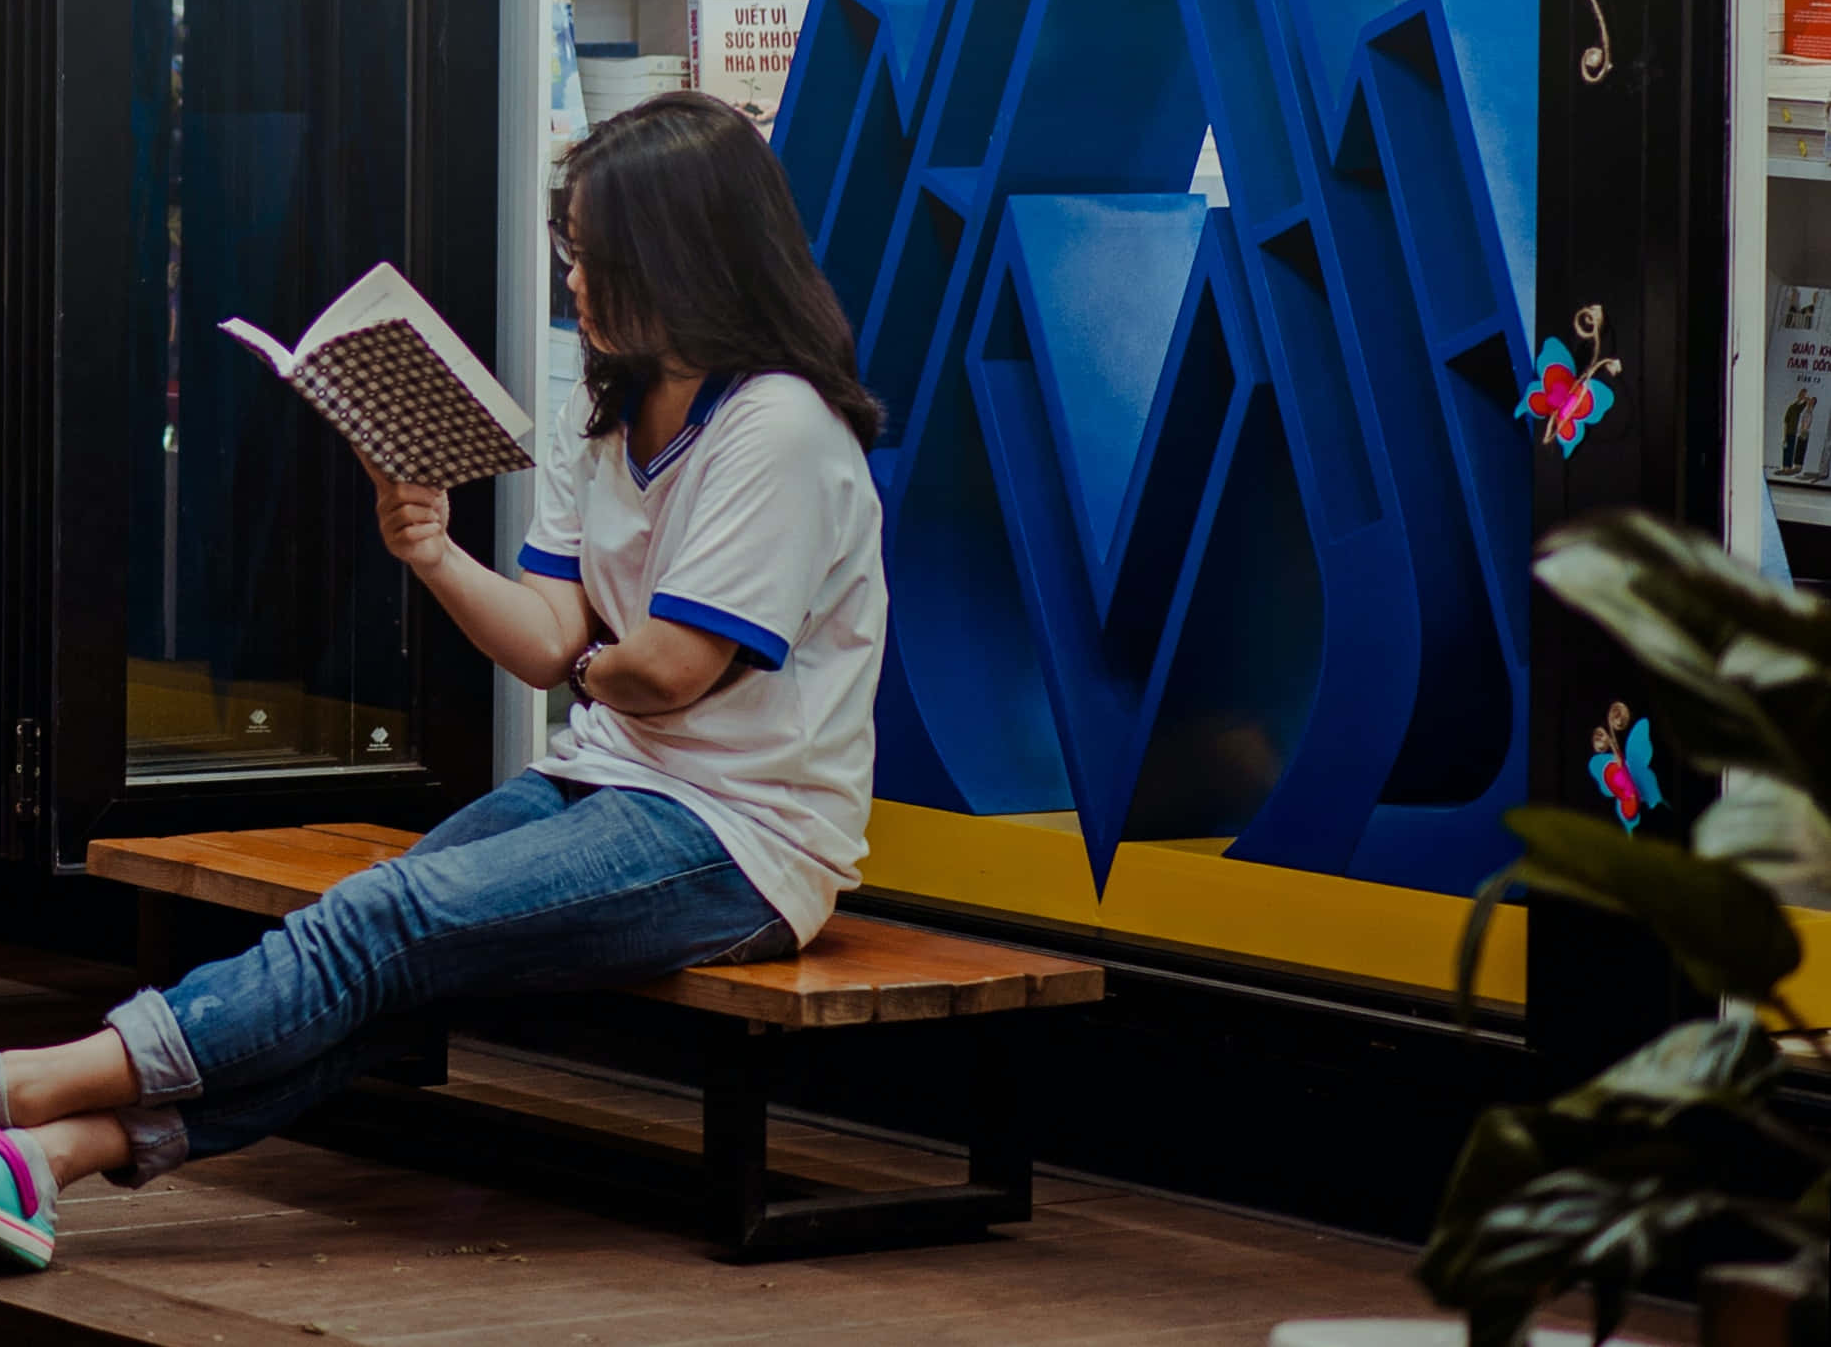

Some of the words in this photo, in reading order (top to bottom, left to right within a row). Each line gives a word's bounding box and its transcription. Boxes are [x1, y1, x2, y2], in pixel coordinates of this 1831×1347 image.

[734, 2, 767, 26] VIẾT
[770, 3, 786, 25] VÌ
[724, 27, 755, 49] SỨC
[724, 51, 755, 72] NHÀ
[759, 50, 792, 72] NÔN
